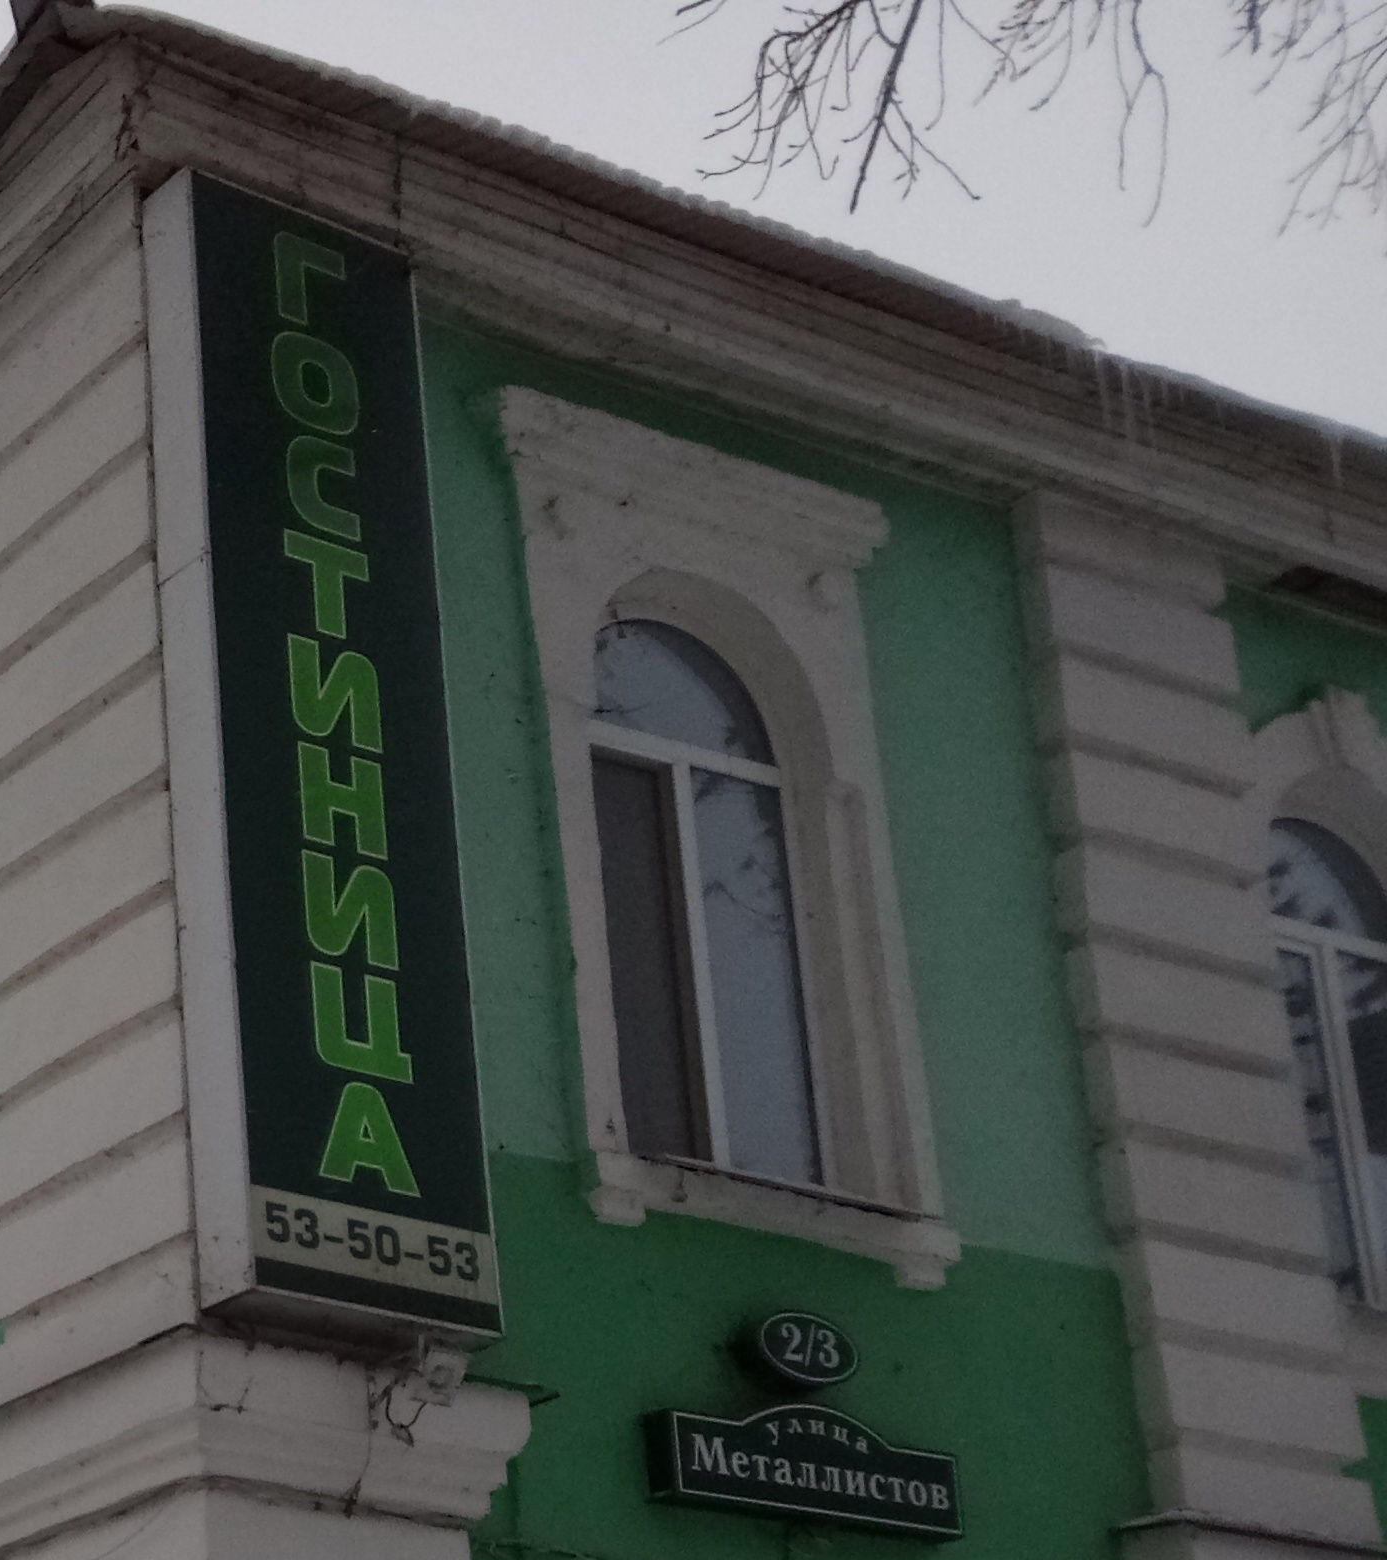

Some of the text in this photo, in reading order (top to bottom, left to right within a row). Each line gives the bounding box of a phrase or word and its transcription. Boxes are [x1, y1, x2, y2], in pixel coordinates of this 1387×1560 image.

[270, 230, 422, 1198] ГОСТИНИЦА
[264, 1201, 480, 1282] 53-50-53
[780, 1321, 841, 1369] 2/3
[690, 1432, 950, 1511] Металлистов
[765, 1416, 869, 1455] улица
